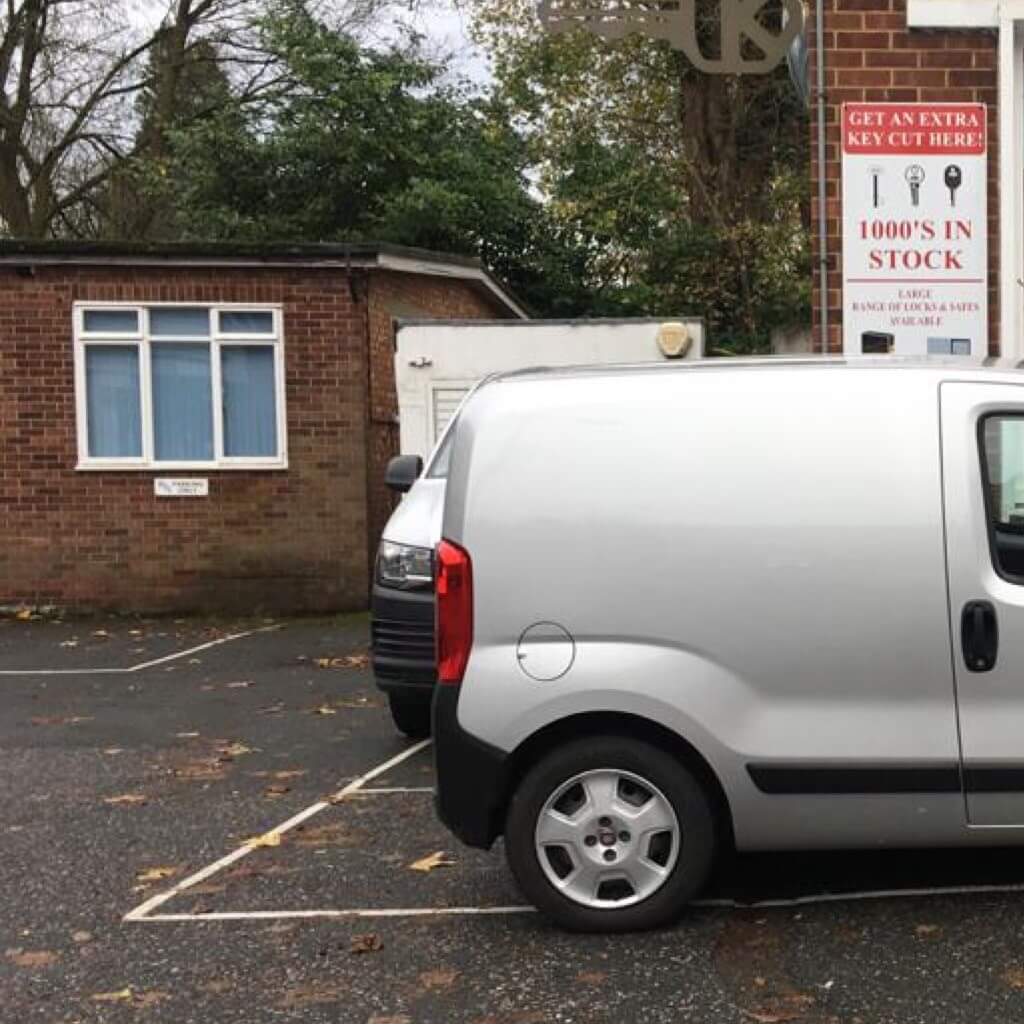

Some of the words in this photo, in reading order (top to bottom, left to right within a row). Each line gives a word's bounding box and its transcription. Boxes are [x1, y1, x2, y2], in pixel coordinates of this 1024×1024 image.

[848, 111, 886, 126] GET
[891, 111, 914, 126] AN
[919, 111, 979, 126] EXTRA
[848, 131, 884, 146] KEY
[888, 131, 924, 146] CUT
[929, 131, 983, 147] HERE!
[859, 218, 936, 241] 1000'S
[944, 219, 972, 240] IN
[868, 248, 964, 271] STOCK
